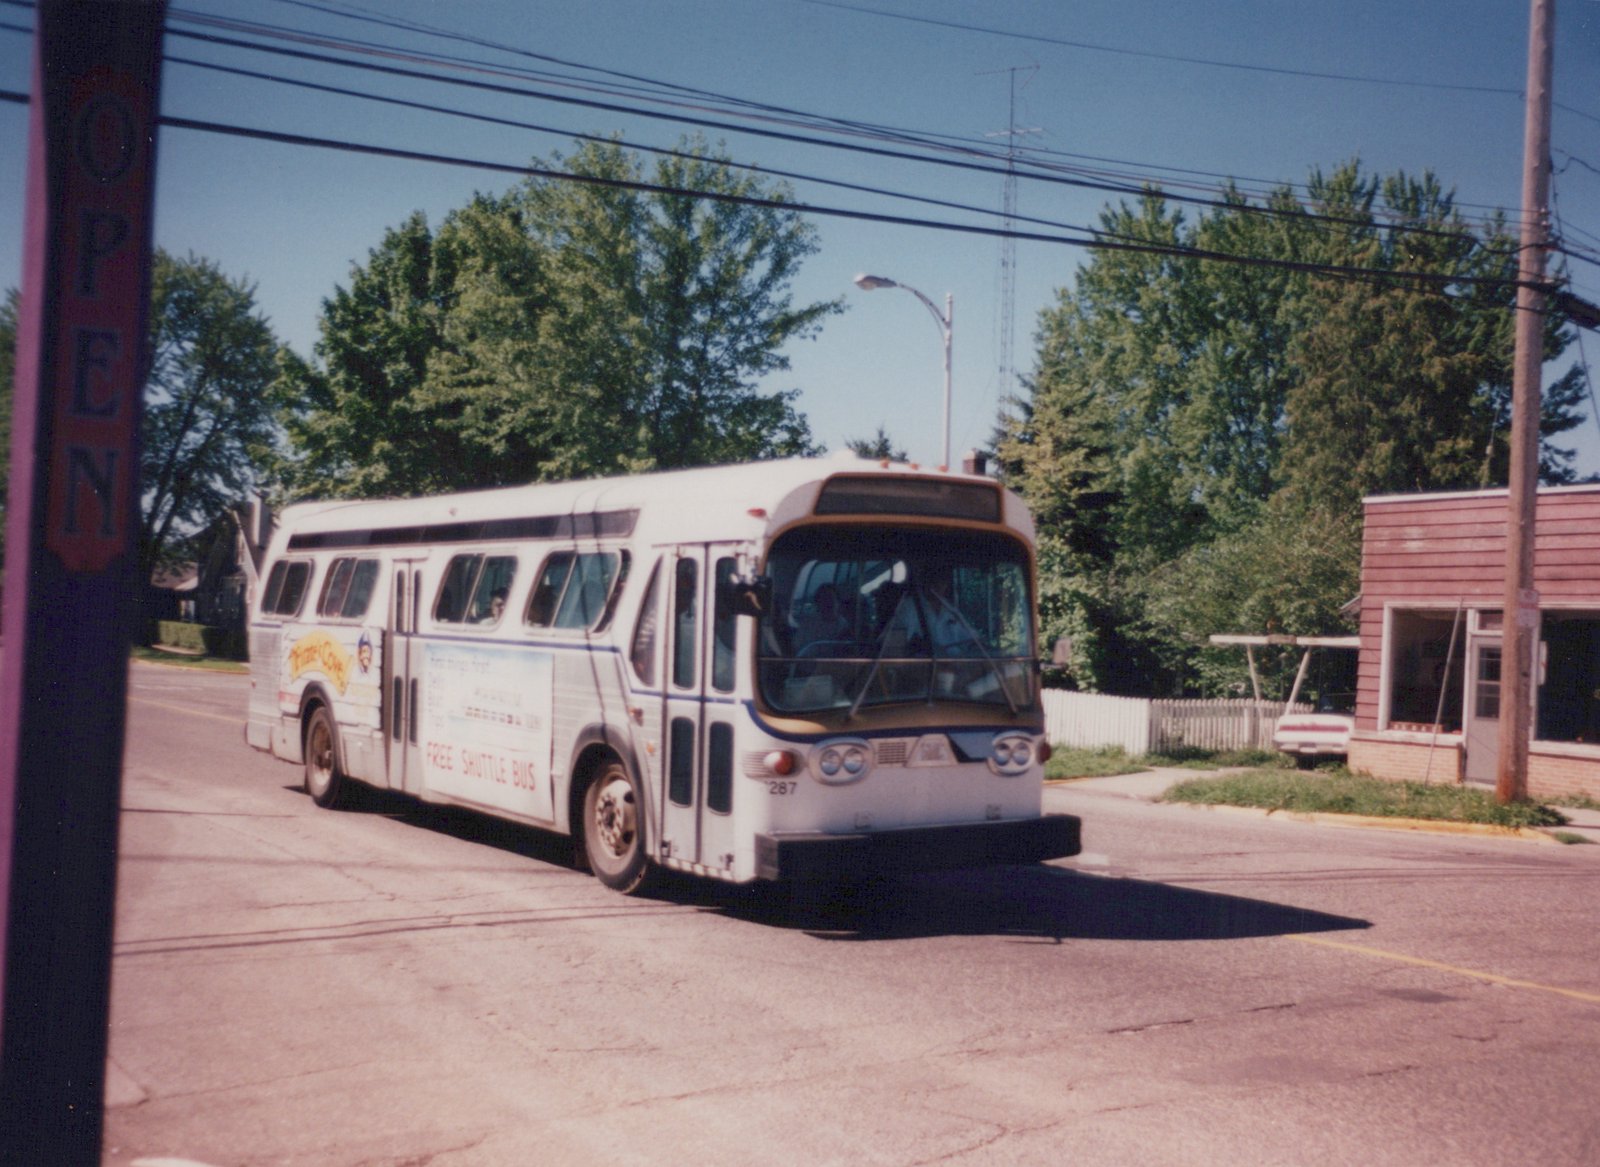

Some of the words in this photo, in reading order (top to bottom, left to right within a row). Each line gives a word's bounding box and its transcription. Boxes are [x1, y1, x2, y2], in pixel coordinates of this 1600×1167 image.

[63, 92, 141, 537] OPEN
[427, 741, 453, 770] FREE
[461, 748, 507, 784] SHUTTLE
[512, 759, 536, 791] BUS
[769, 780, 797, 795] 287
